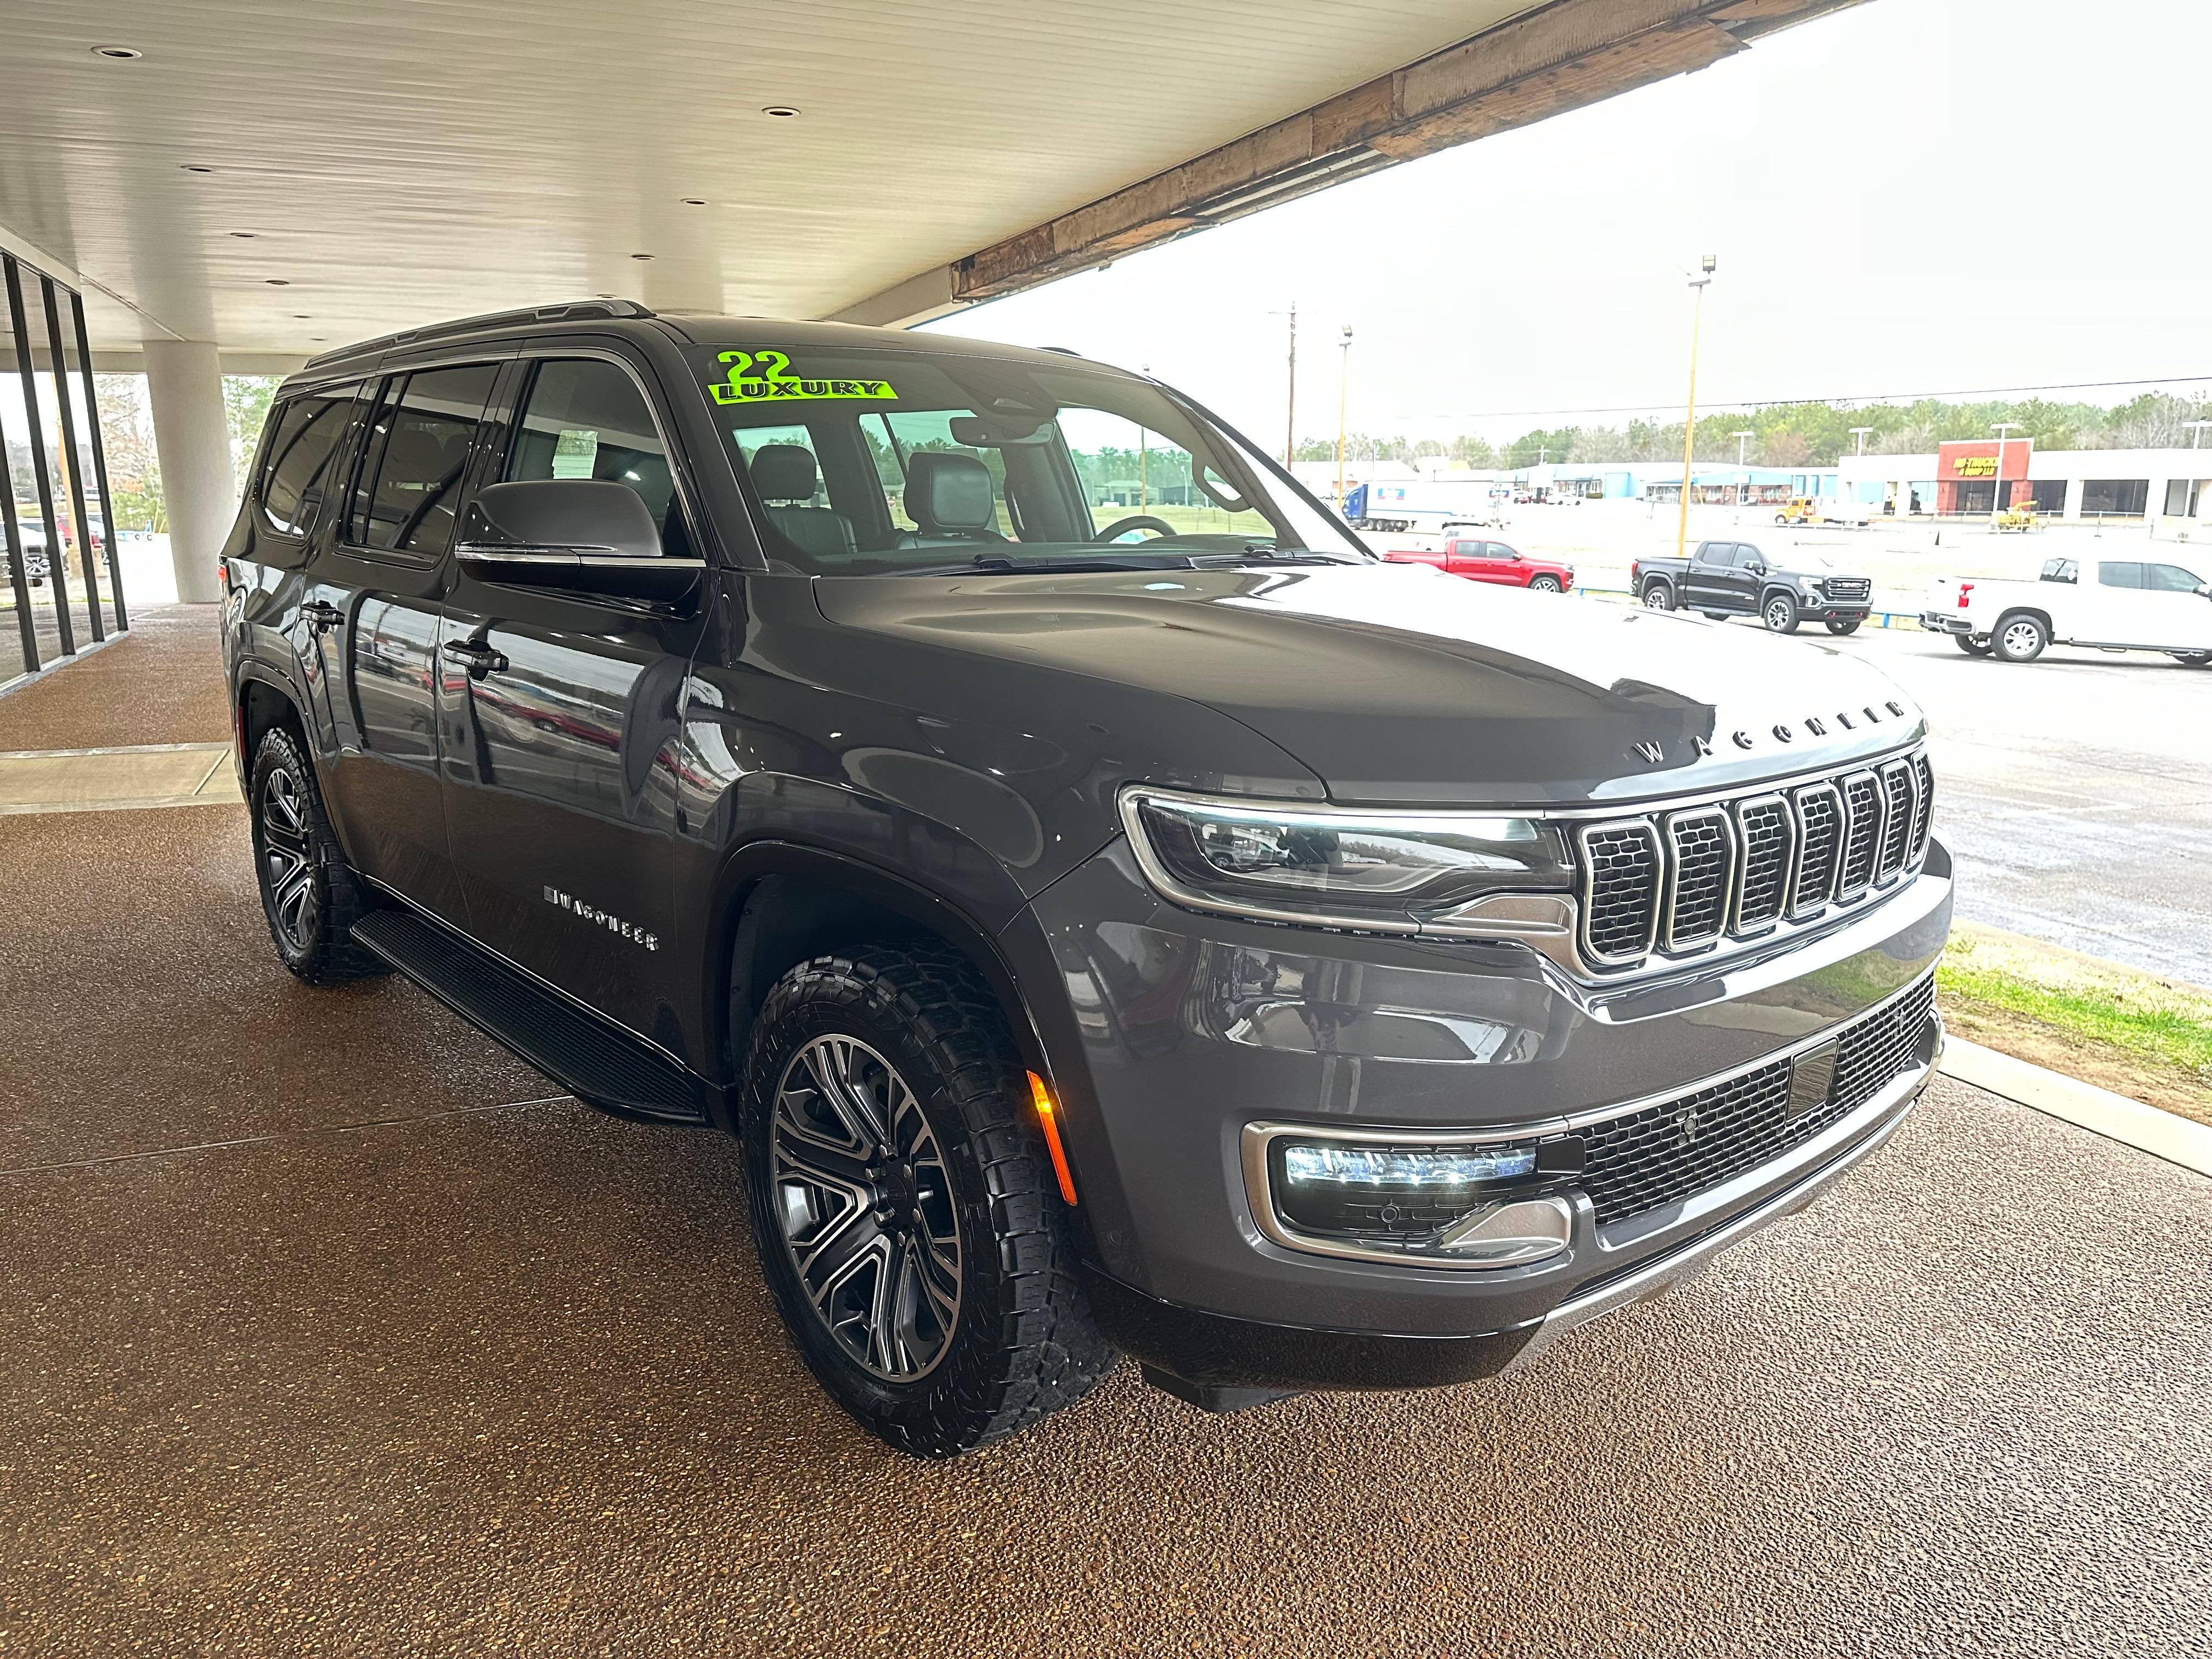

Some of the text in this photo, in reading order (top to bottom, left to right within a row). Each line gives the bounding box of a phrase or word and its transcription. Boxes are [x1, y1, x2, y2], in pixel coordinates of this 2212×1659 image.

[717, 351, 801, 383] 22
[719, 381, 882, 399] LUXURY
[560, 892, 659, 951] WAGONEER
